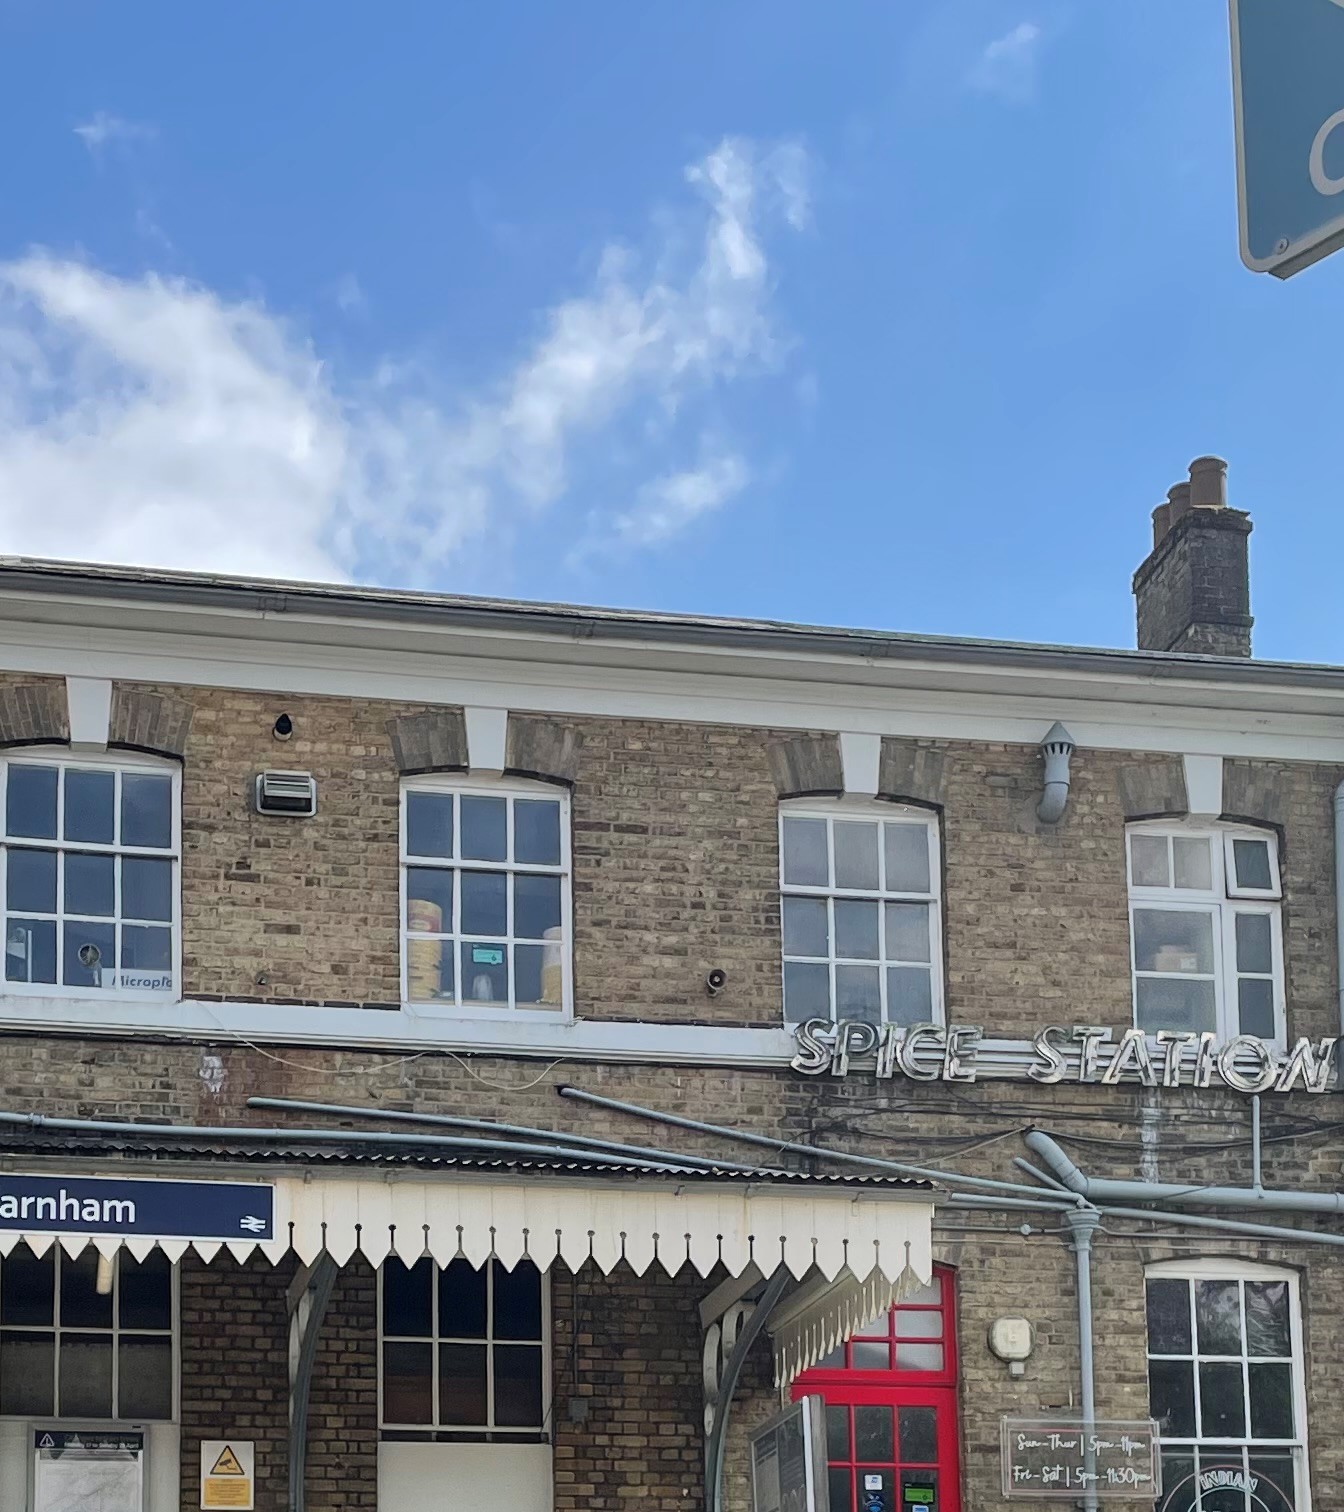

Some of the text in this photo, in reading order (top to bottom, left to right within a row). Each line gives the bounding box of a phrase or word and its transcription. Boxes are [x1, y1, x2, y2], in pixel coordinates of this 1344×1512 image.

[790, 1018, 1339, 1094] SPICE STATION
[1199, 1470, 1259, 1493] INDIAN
